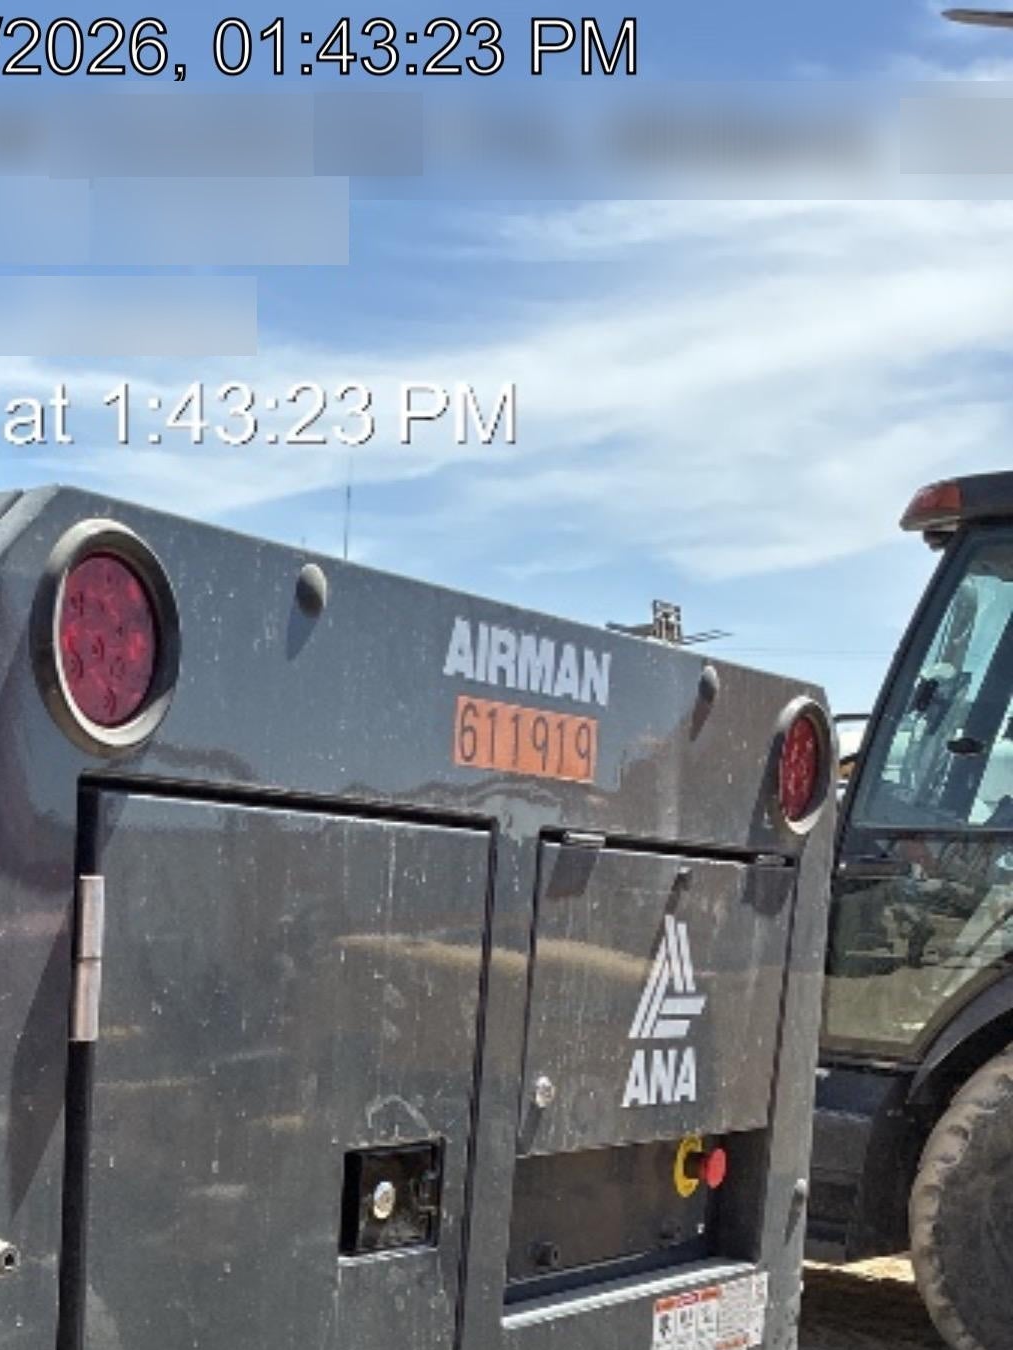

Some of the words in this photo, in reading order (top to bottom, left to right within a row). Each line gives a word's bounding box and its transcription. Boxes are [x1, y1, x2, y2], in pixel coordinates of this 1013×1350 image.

[442, 616, 612, 706] AIRMAN
[460, 701, 592, 777] 611919
[620, 1047, 696, 1108] ANA
